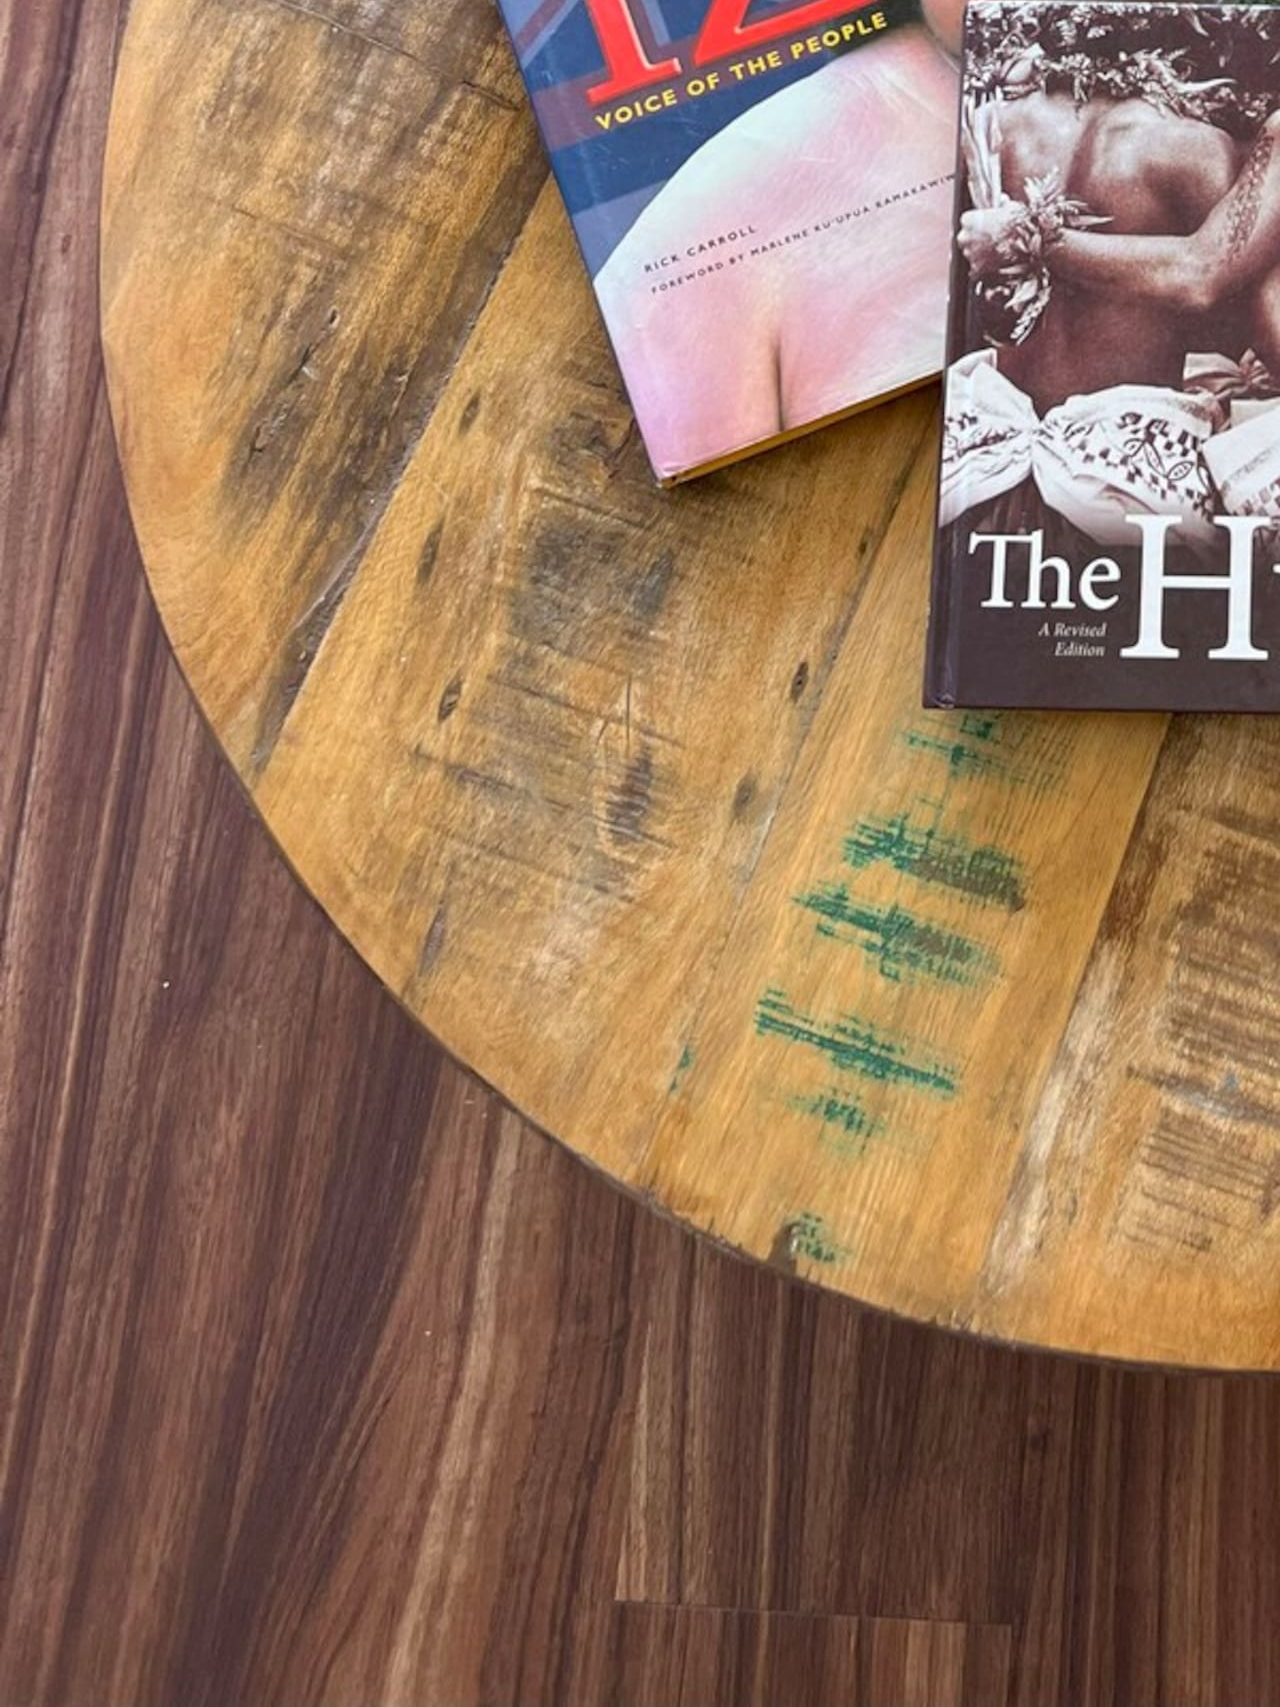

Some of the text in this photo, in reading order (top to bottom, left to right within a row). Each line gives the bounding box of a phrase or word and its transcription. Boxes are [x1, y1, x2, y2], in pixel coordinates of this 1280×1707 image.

[595, 12, 888, 131] VOICE OF THE PEOPLE
[644, 225, 757, 273] RICK CARROLL
[651, 261, 724, 294] FOREWORD
[729, 253, 745, 266] BY
[750, 229, 809, 257] MARLENE
[876, 173, 956, 209] KAMAKAWIW
[969, 529, 1121, 611] The
[1038, 621, 1107, 637] A Revised
[1054, 641, 1106, 657] Edition
